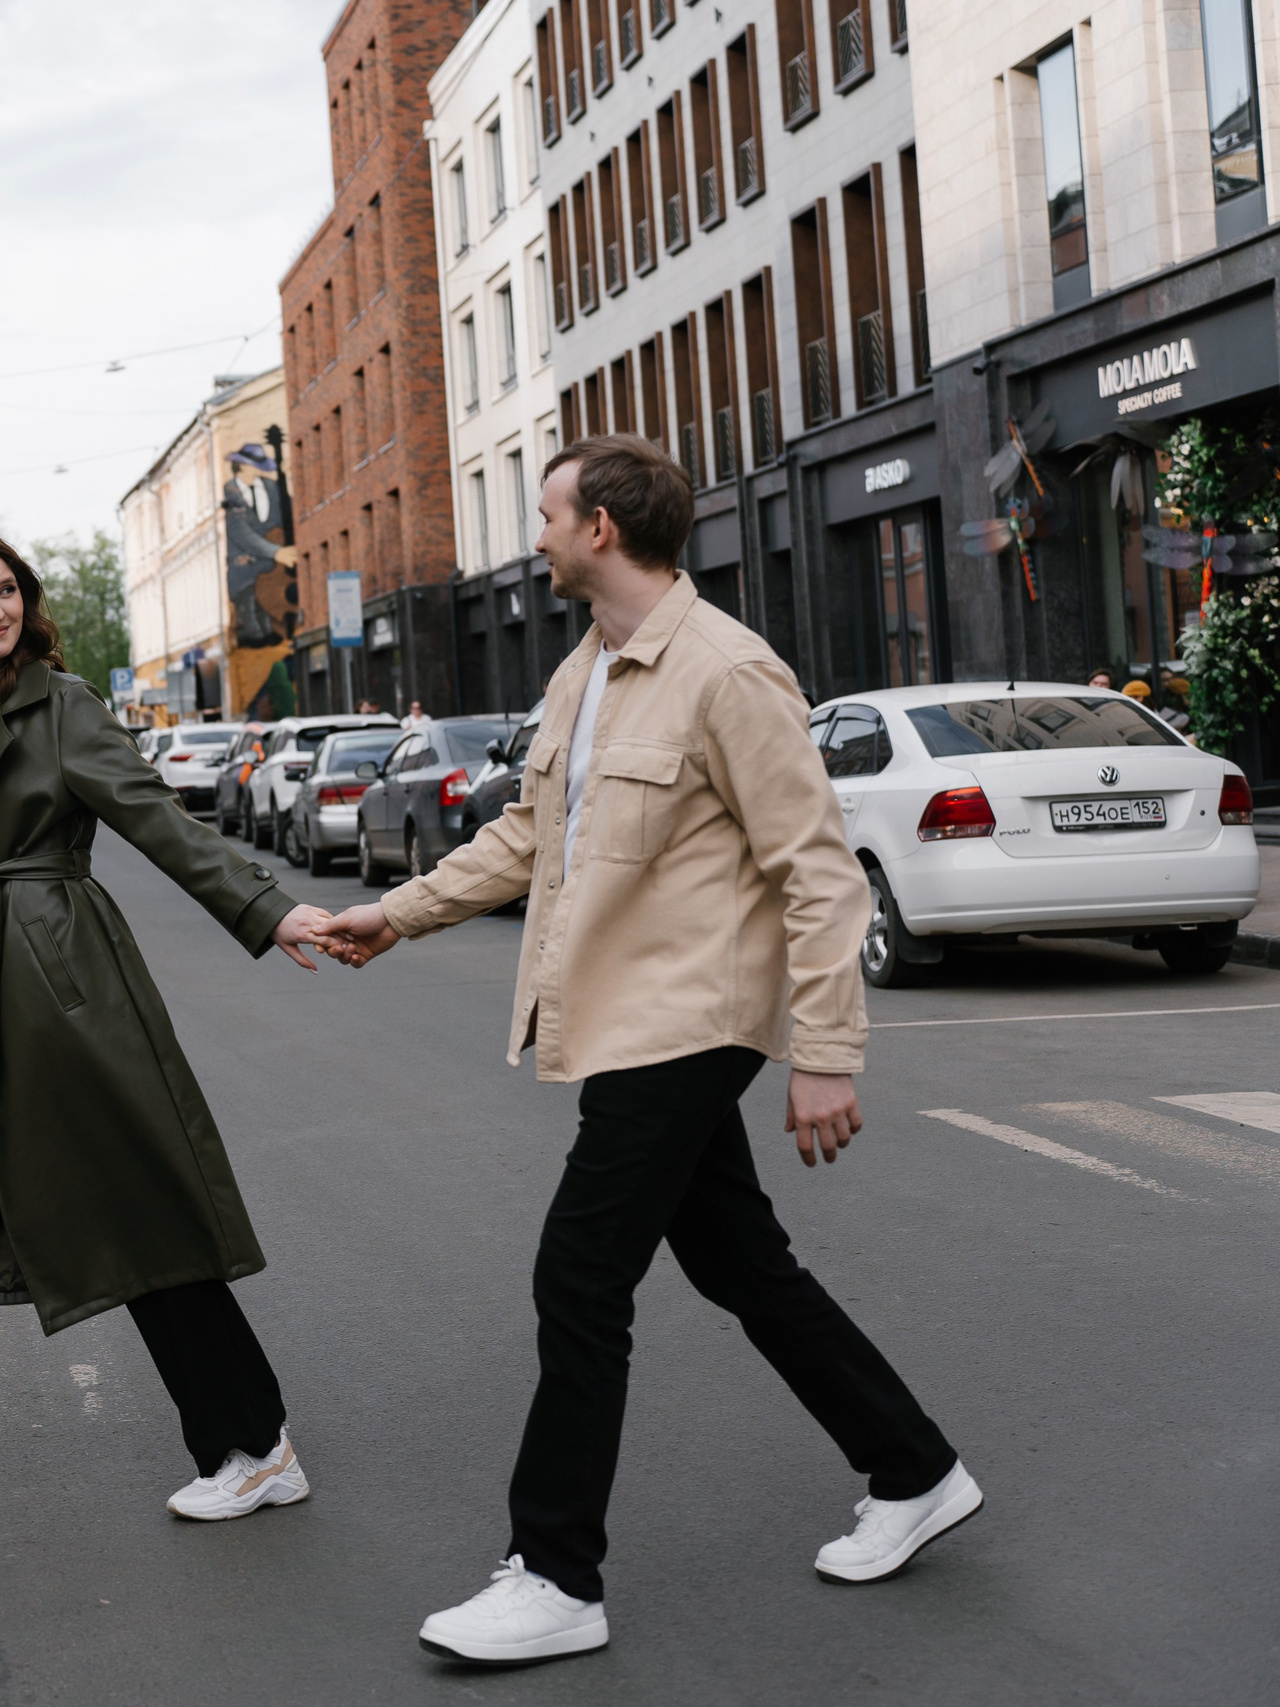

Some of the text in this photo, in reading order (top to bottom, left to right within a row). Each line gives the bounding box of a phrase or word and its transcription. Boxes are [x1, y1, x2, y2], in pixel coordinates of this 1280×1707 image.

[1117, 382, 1183, 415] SPECIALTY COFFEE
[875, 458, 905, 490] ASKO
[1059, 801, 1160, 823] Н954ОЕ 152
